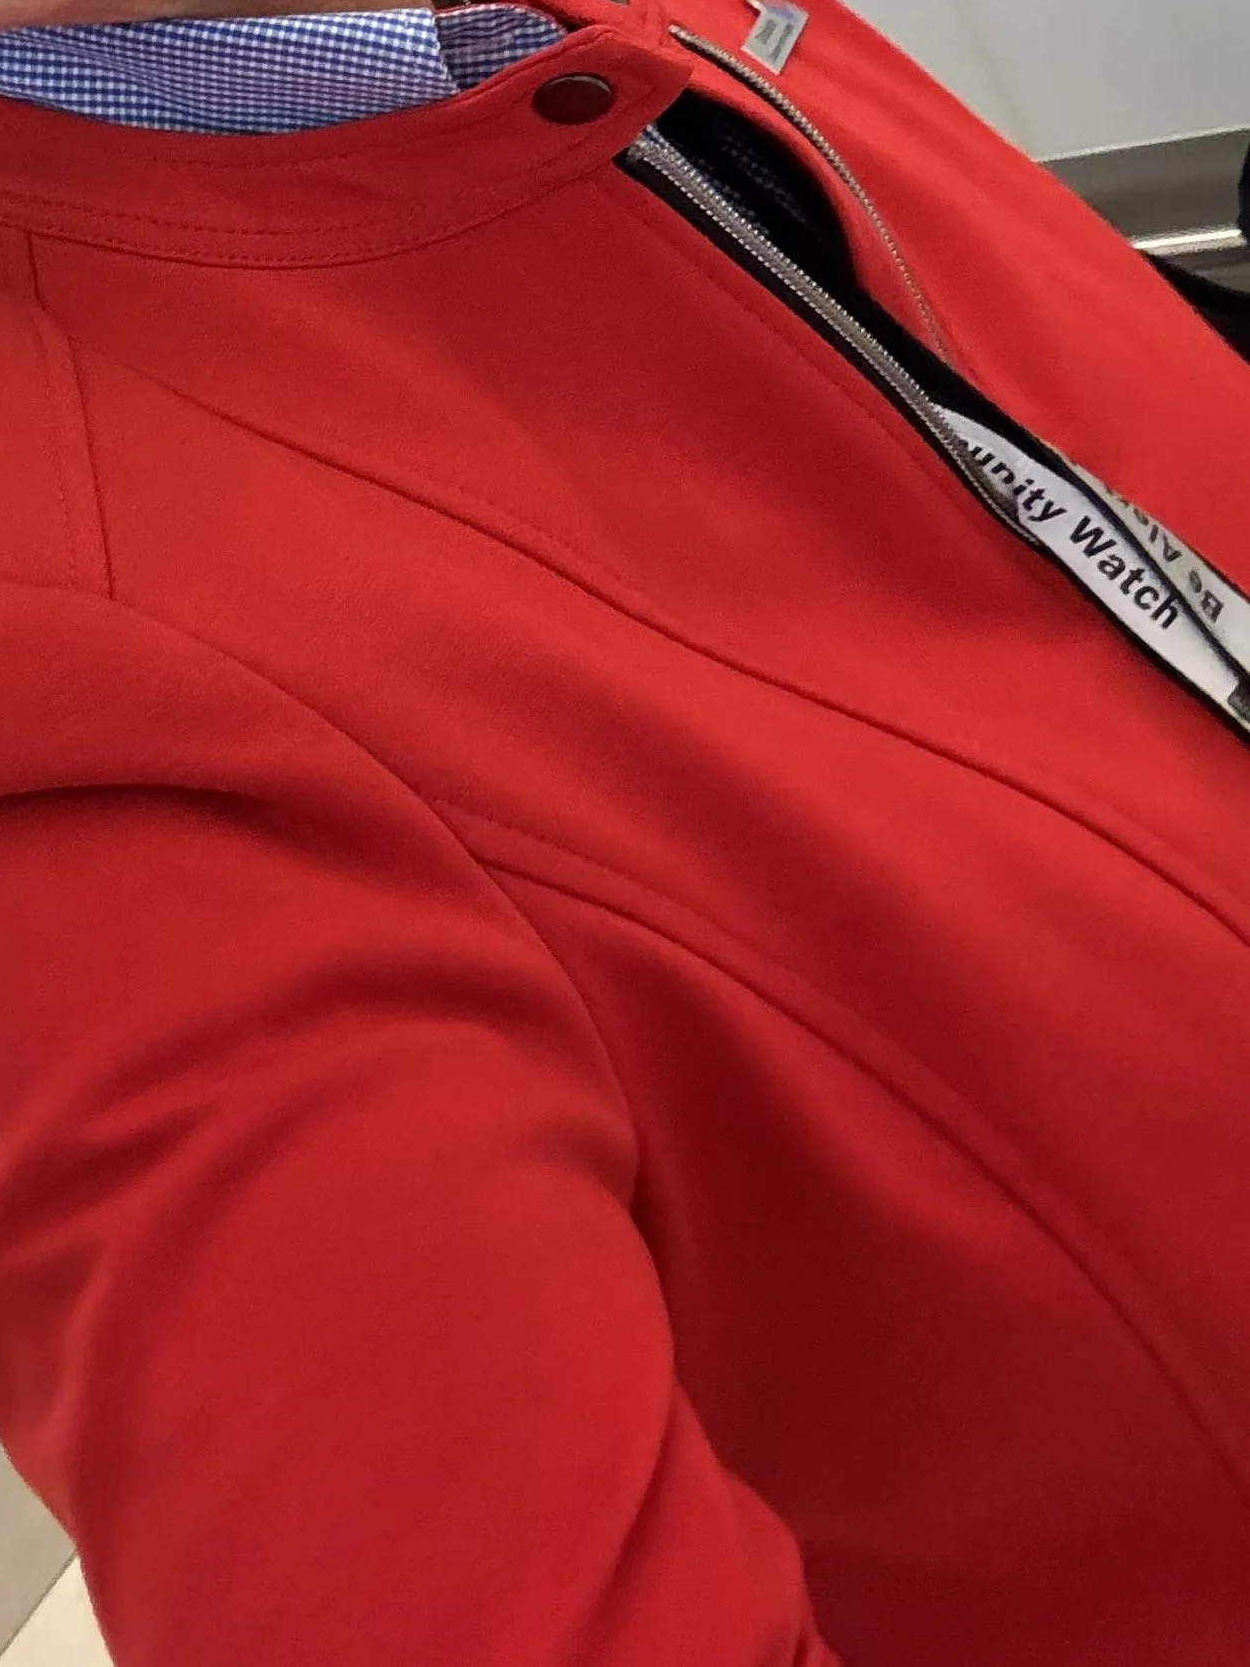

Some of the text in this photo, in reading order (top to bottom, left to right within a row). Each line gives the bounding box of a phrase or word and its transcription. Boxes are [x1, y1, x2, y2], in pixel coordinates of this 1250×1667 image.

[958, 439, 1179, 629] unity Watch
[1188, 569, 1225, 624] Be
